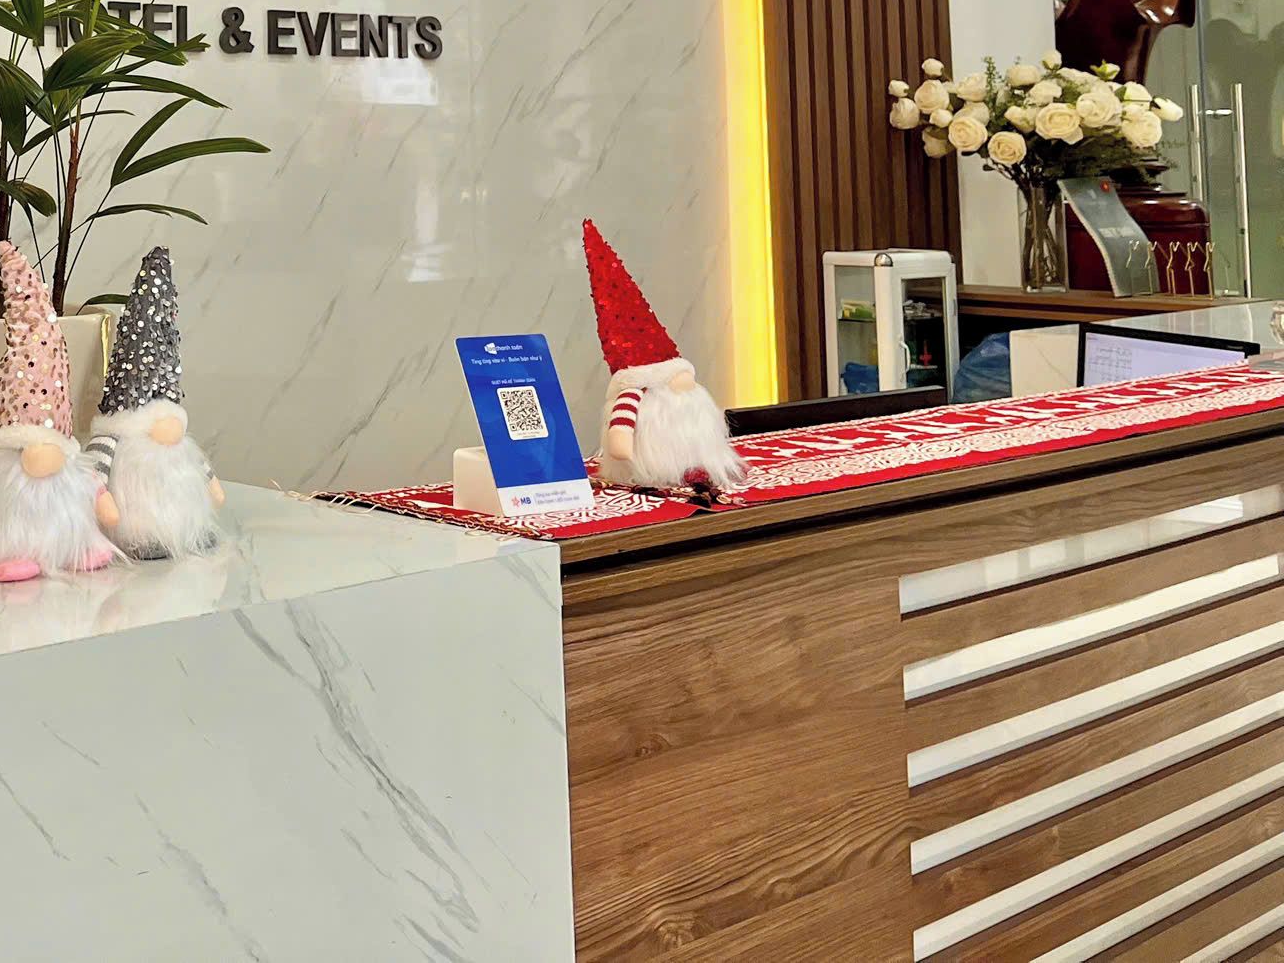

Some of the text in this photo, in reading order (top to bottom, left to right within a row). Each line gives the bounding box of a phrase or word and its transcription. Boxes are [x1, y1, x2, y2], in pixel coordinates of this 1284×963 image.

[218, 6, 255, 55] &
[267, 8, 443, 60] EVENTS
[520, 496, 532, 505] MB
